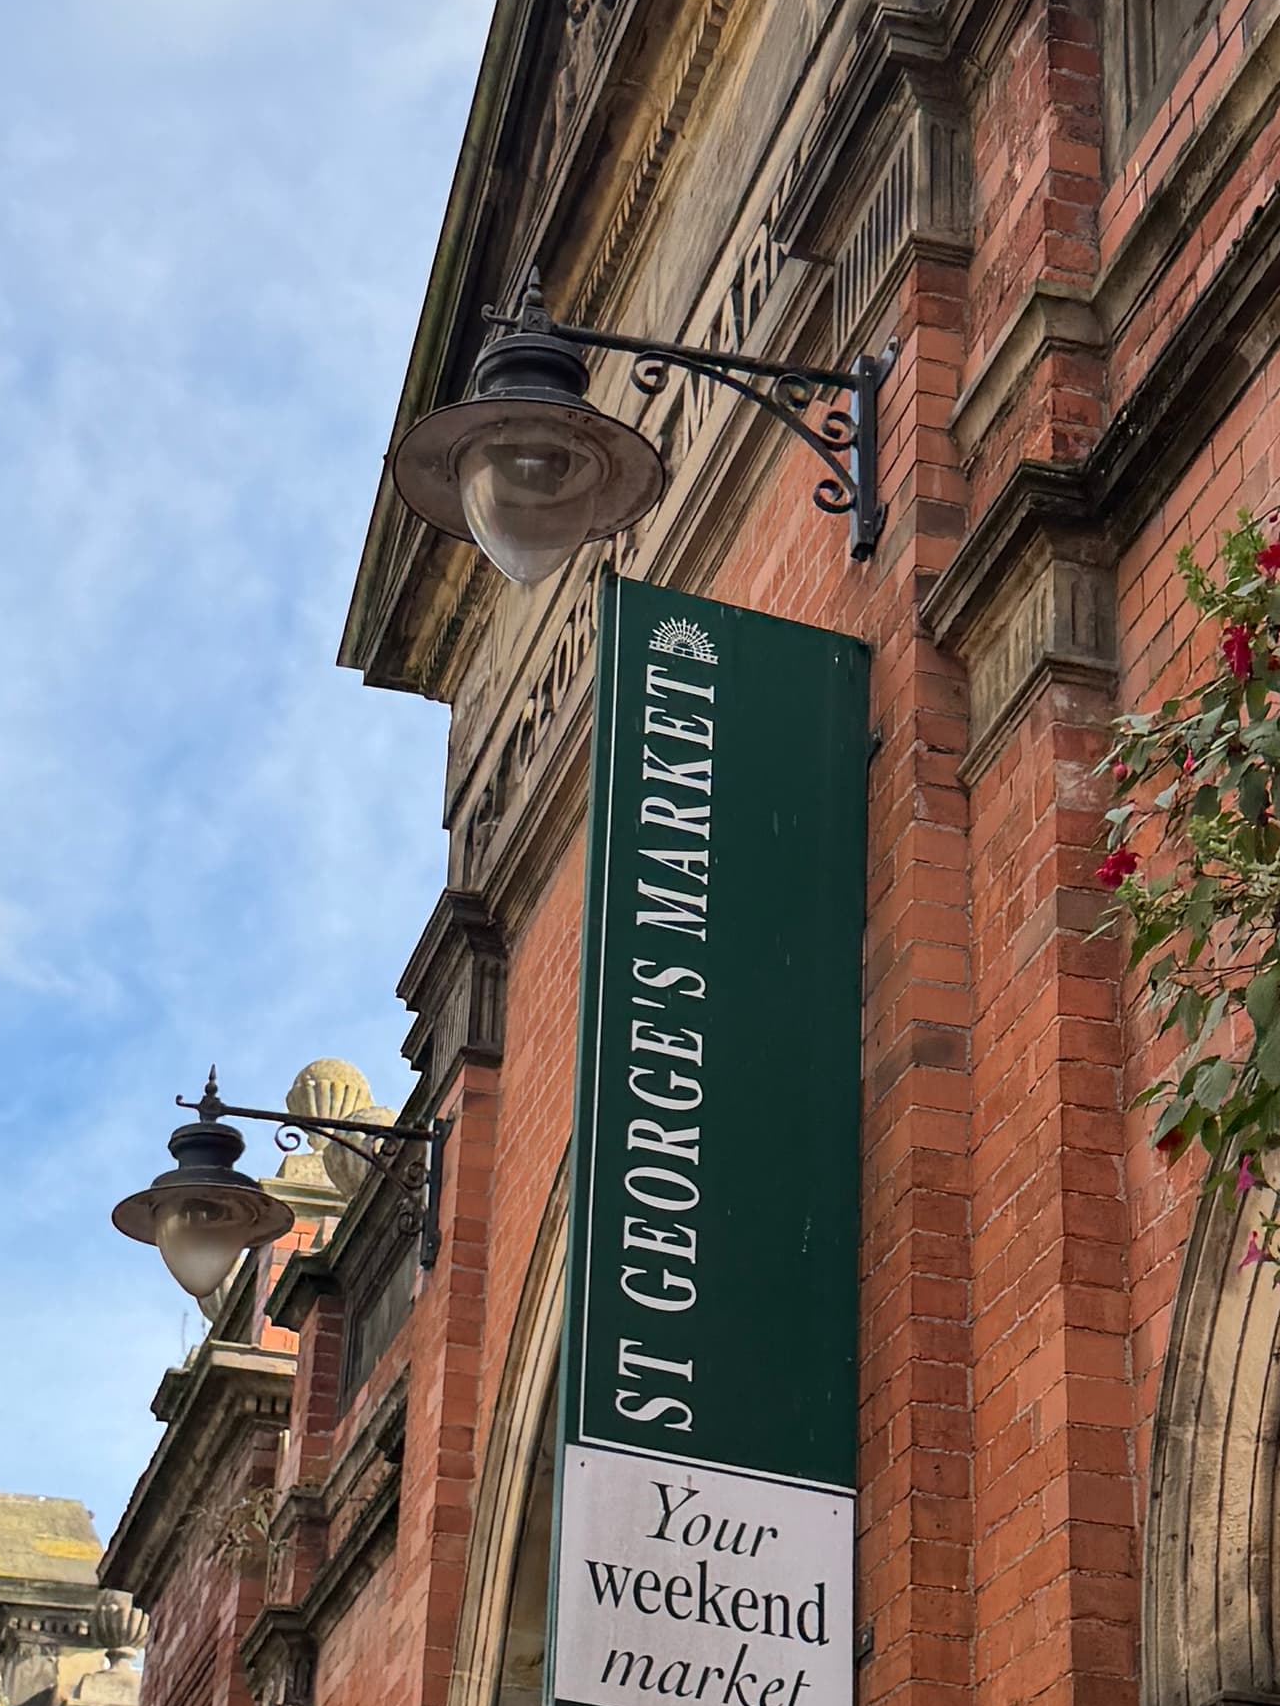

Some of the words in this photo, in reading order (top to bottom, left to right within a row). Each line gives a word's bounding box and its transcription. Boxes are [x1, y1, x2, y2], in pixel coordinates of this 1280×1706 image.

[636, 664, 715, 941] MARKET
[620, 957, 707, 1312] GEORGE'S
[615, 1338, 694, 1432] ST
[645, 1480, 778, 1557] Your
[584, 1559, 830, 1647] weekend
